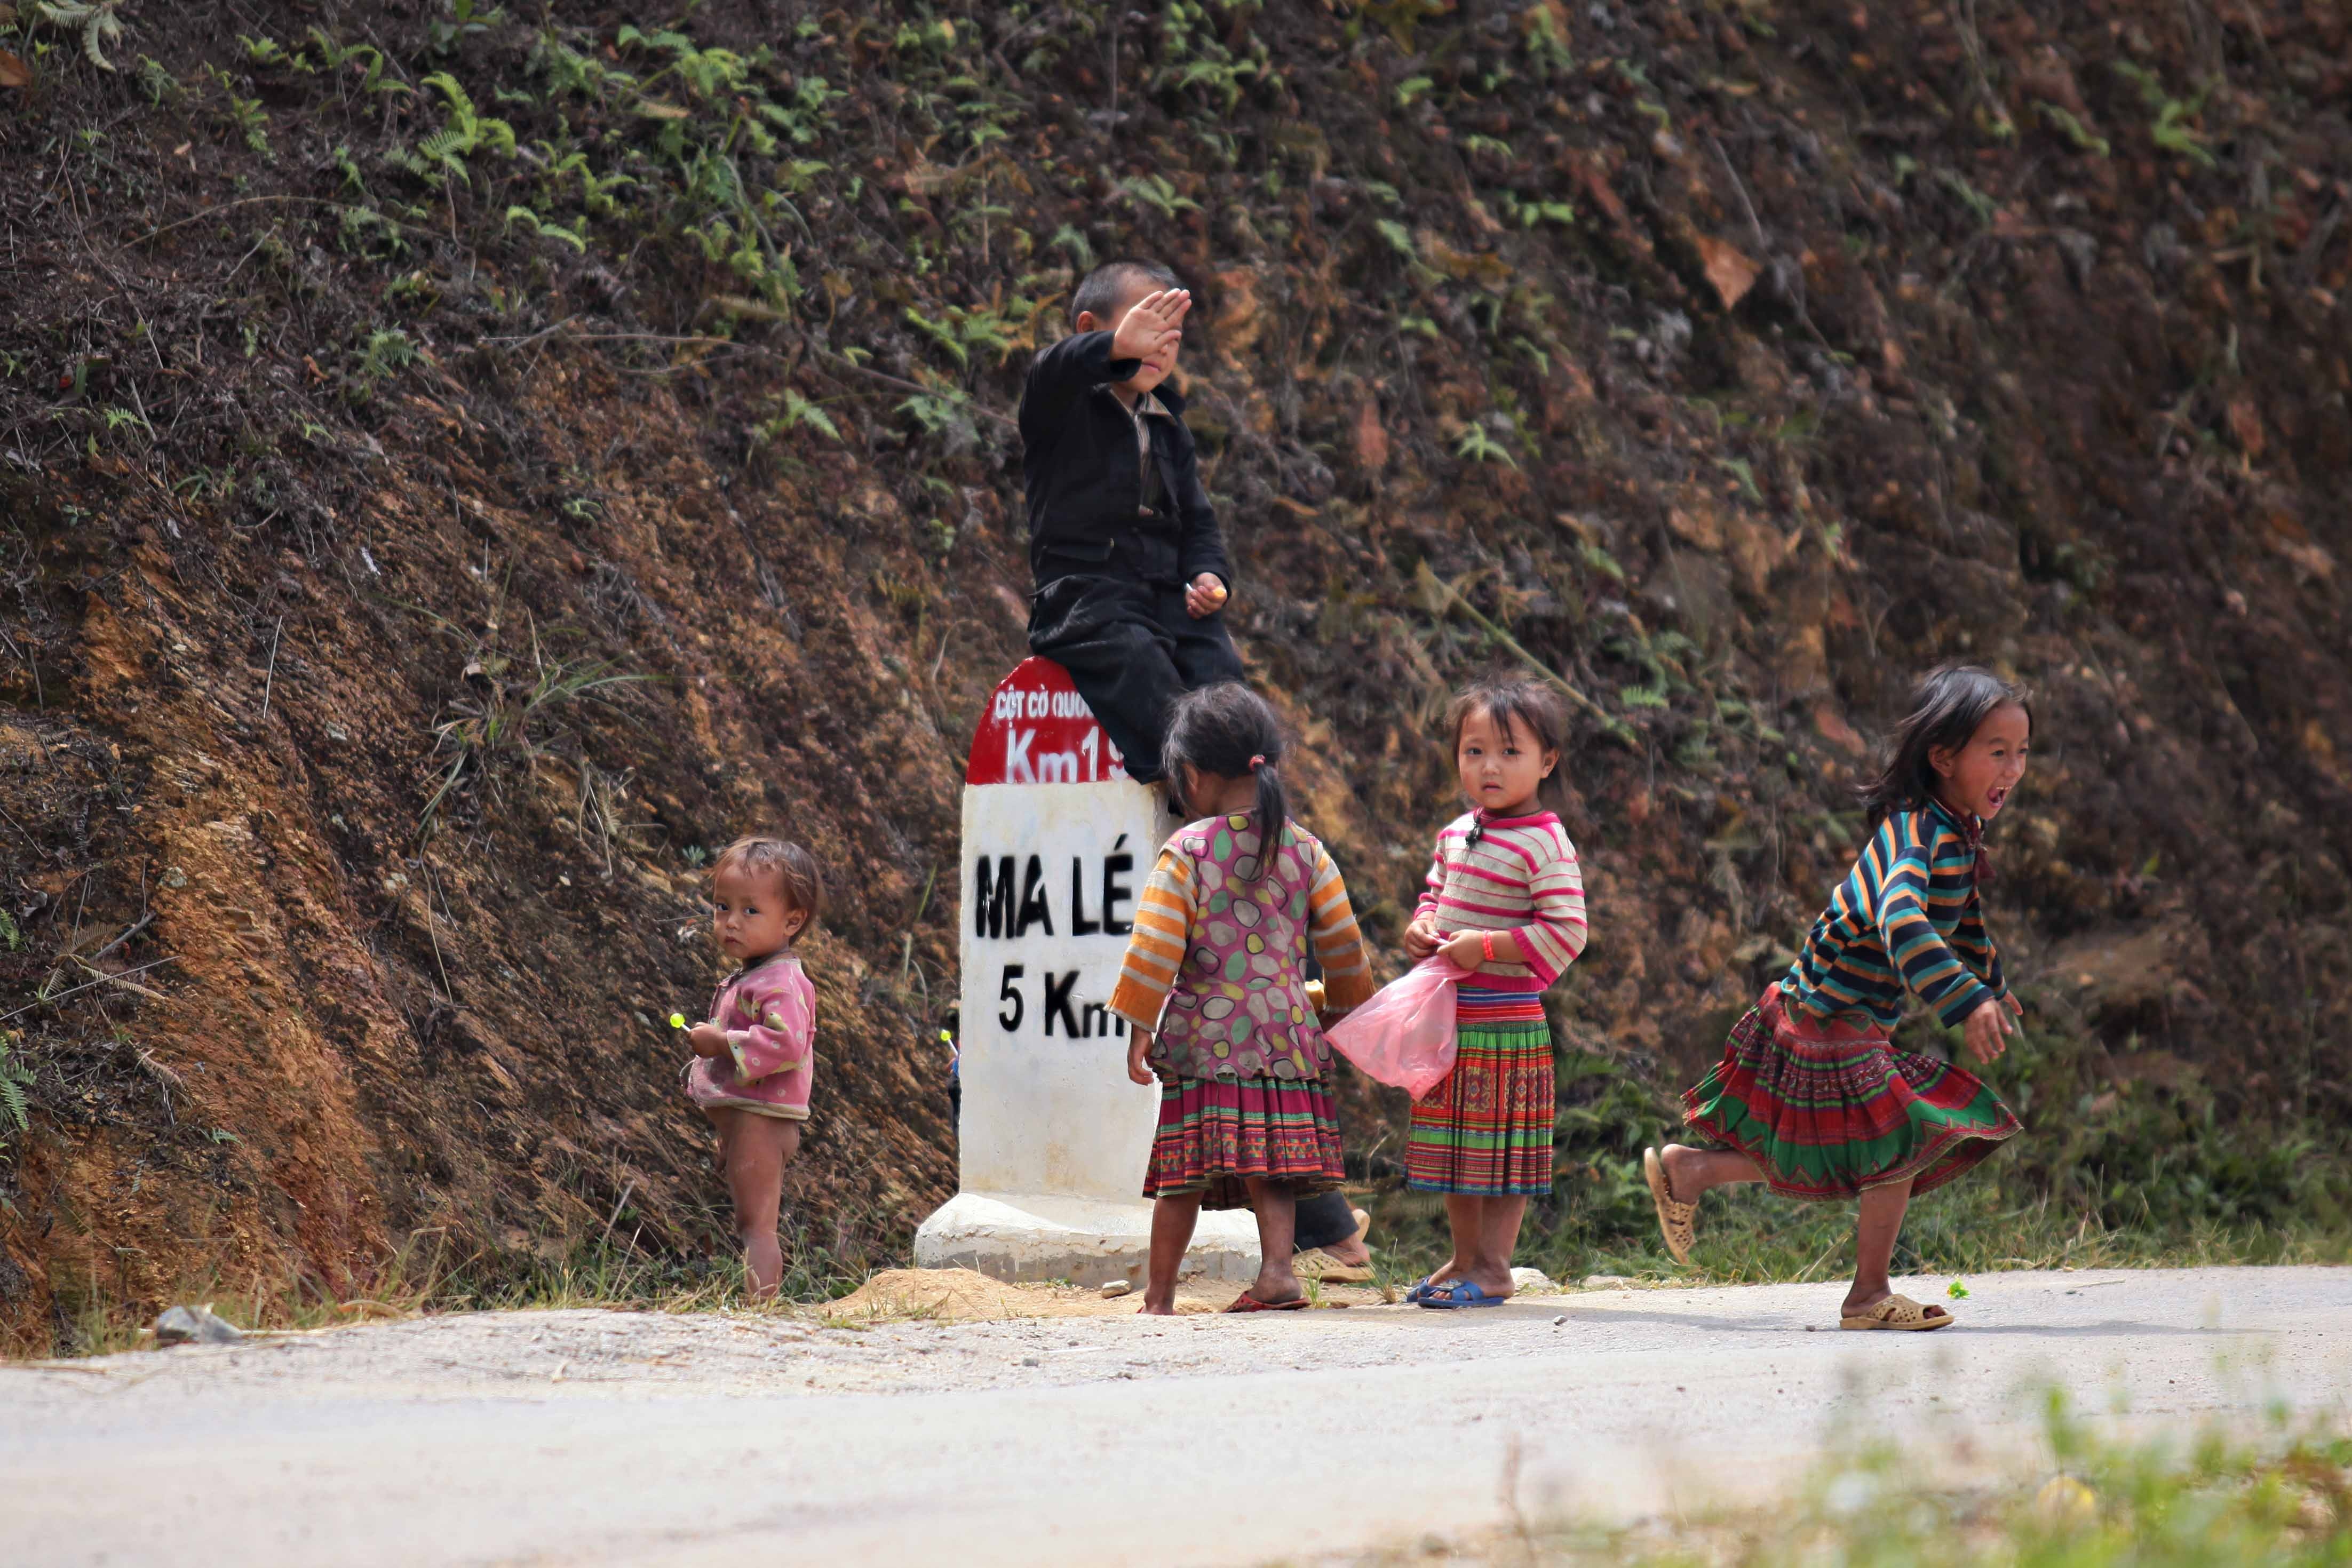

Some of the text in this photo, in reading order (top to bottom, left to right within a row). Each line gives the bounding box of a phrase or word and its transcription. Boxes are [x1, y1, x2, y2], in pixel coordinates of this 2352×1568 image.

[1053, 691, 1094, 718] QUO
[976, 833, 1134, 938] MA LÉ
[999, 965, 1124, 1038] 5 Km
